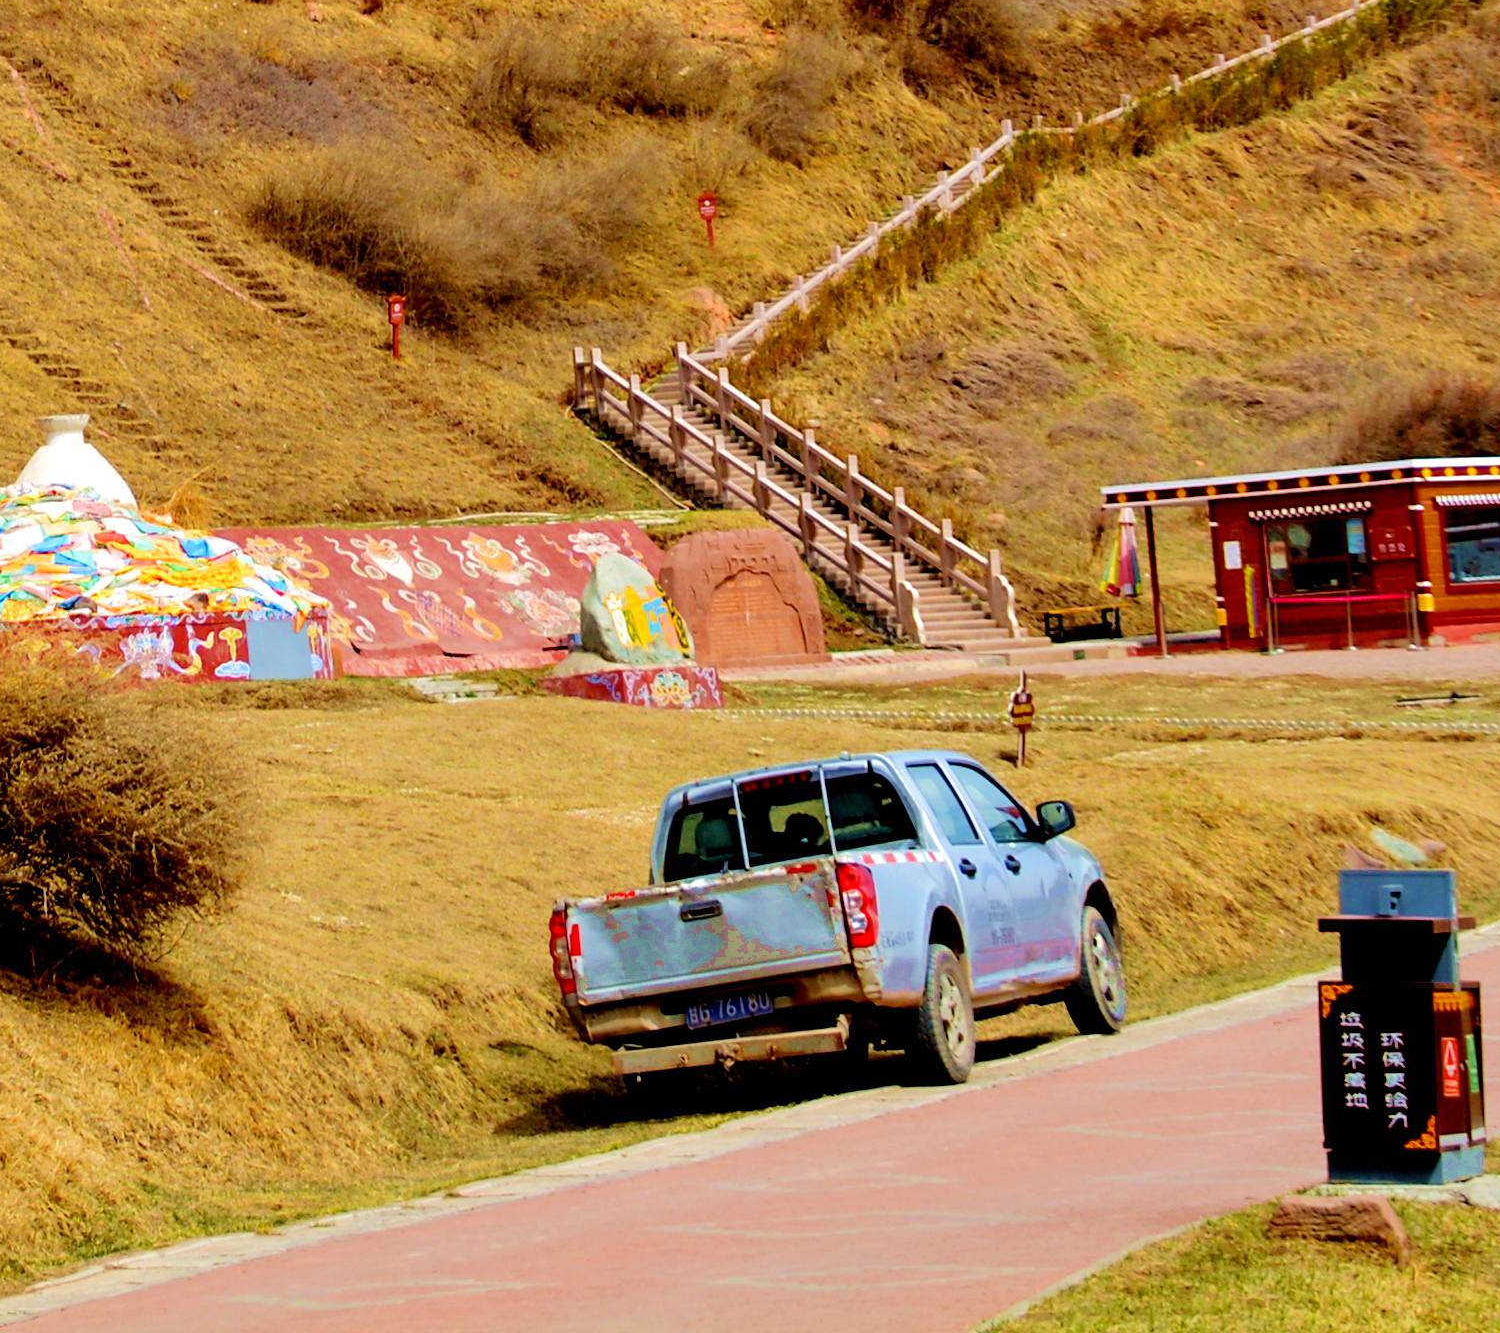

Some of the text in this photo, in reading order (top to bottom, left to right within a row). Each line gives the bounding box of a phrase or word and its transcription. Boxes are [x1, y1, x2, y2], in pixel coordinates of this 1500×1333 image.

[1380, 1032, 1408, 1129] 环保更给力
